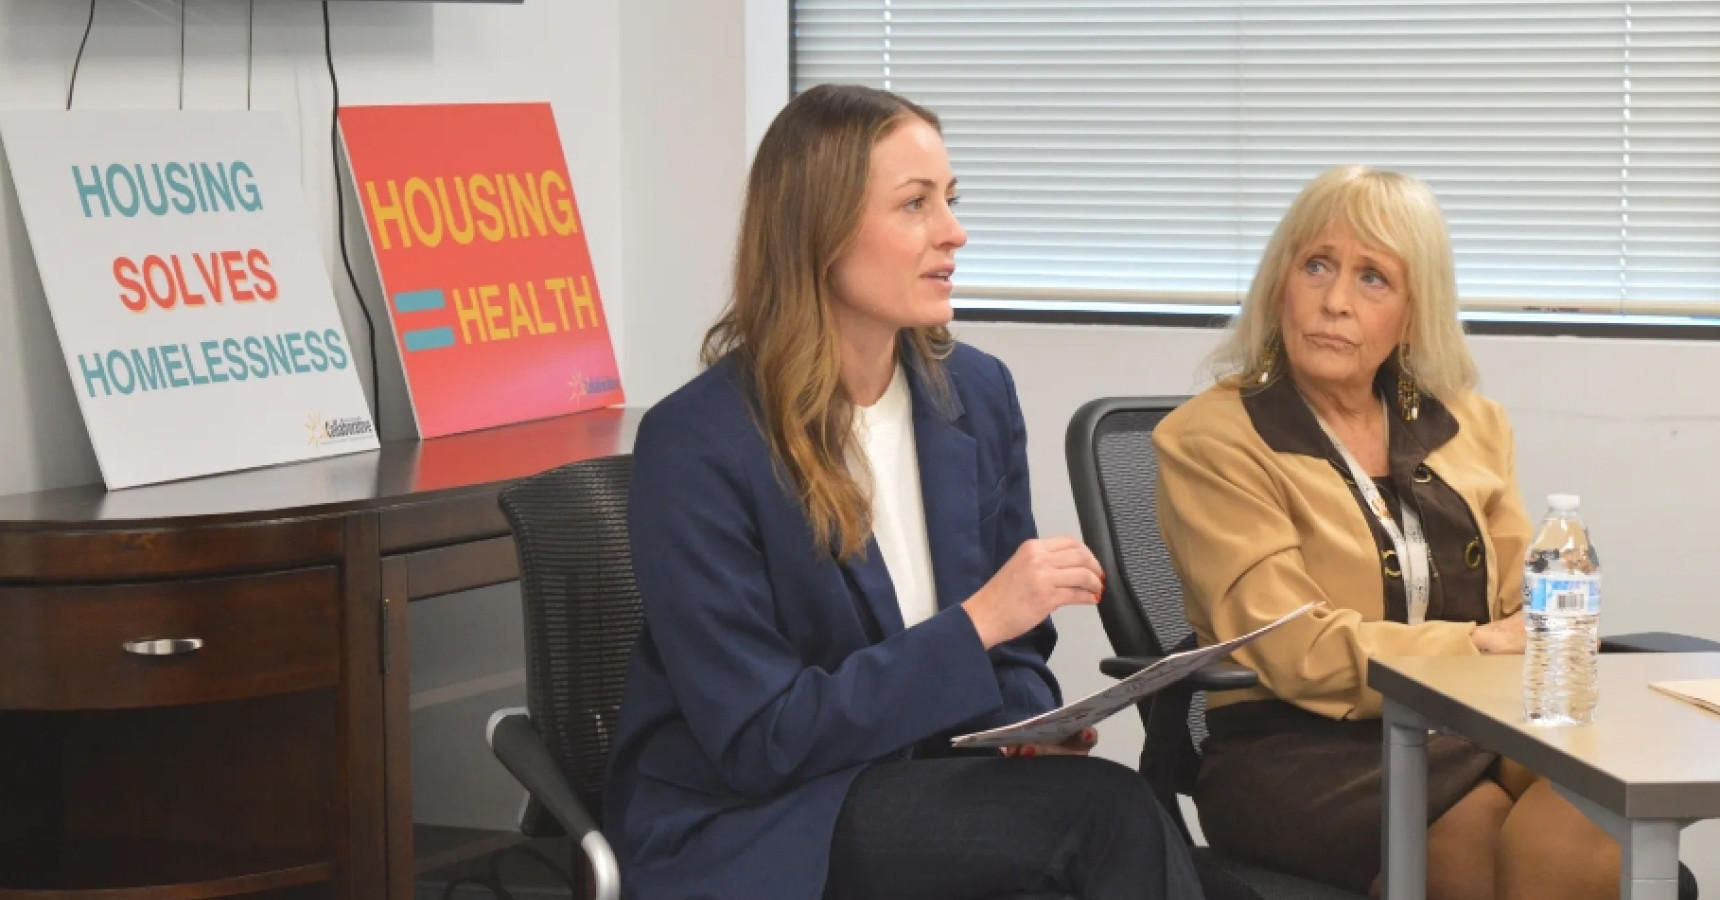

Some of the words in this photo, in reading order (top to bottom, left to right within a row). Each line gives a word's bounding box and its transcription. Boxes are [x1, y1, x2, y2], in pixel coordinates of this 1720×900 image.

[72, 161, 263, 217] HOUSING
[365, 169, 578, 250] HOUSING
[112, 248, 279, 313] SOLVES
[452, 276, 599, 344] HEALTH
[78, 328, 348, 398] HOMELESSNESS
